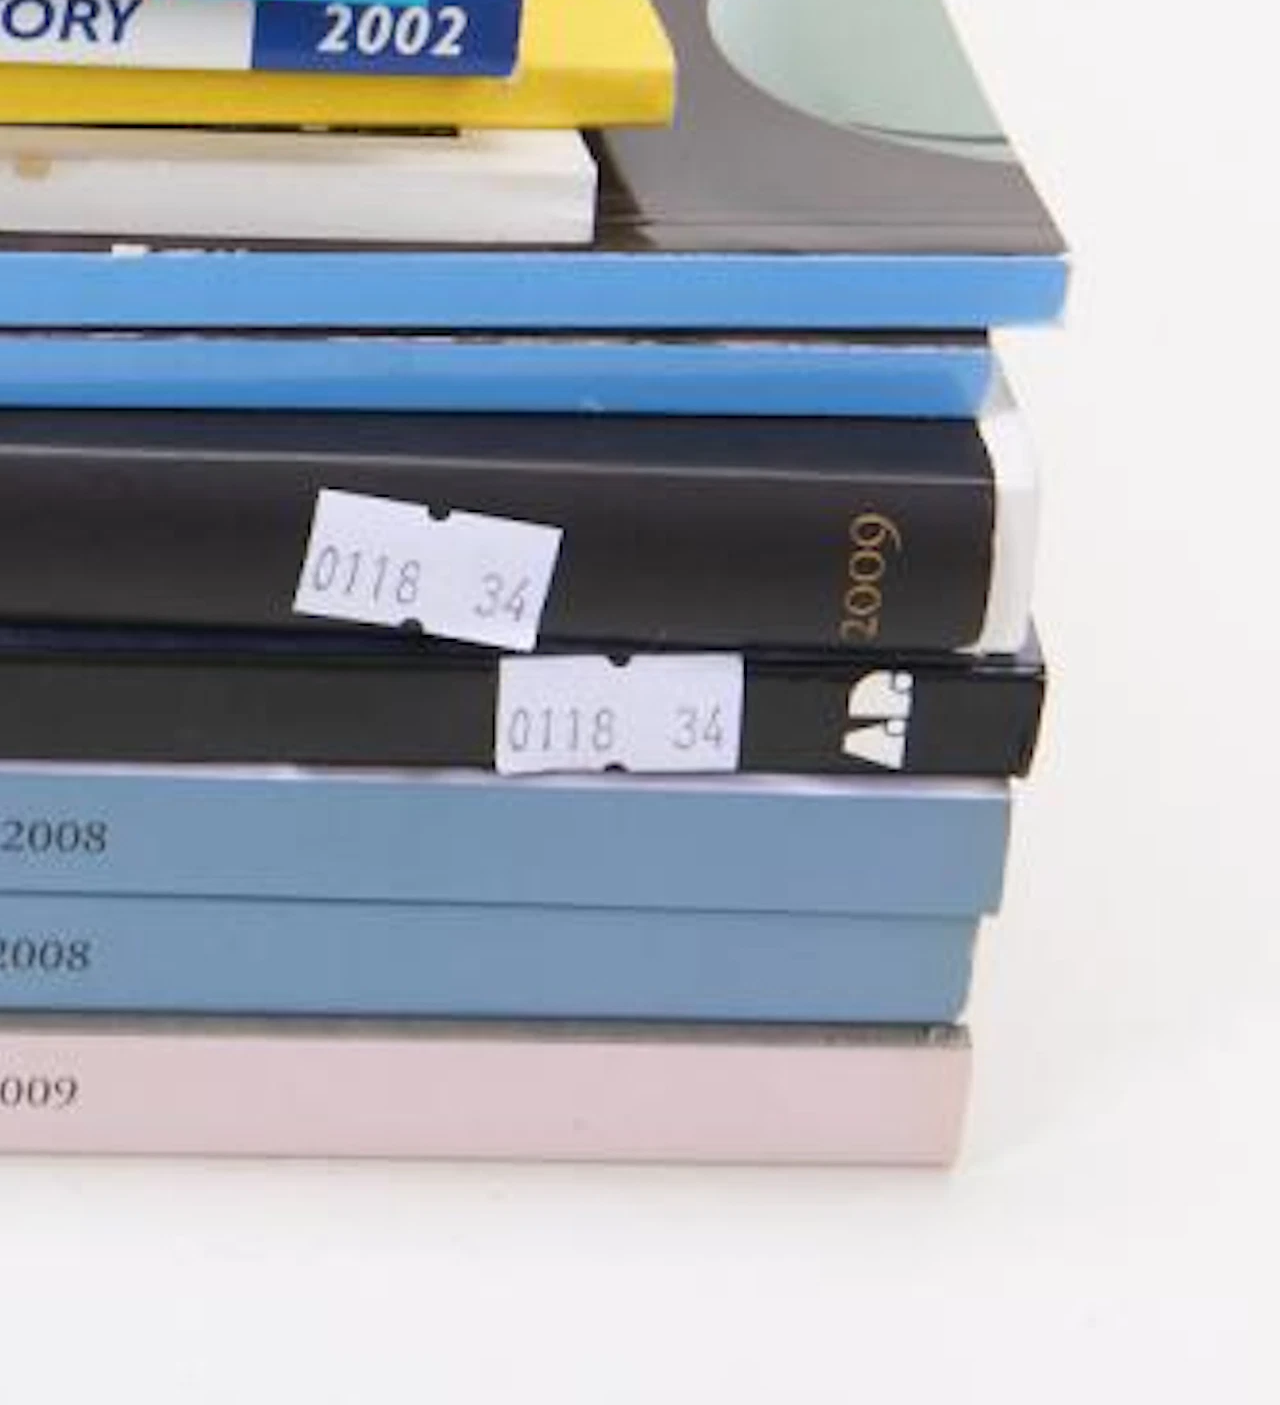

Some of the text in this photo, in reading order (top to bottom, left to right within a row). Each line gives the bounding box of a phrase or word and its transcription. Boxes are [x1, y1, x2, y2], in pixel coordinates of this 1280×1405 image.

[315, 3, 467, 59] 2002
[309, 541, 531, 625] 0118 34
[840, 512, 903, 640] 2009
[507, 702, 729, 754] 0118 34
[0, 815, 109, 855] 2008
